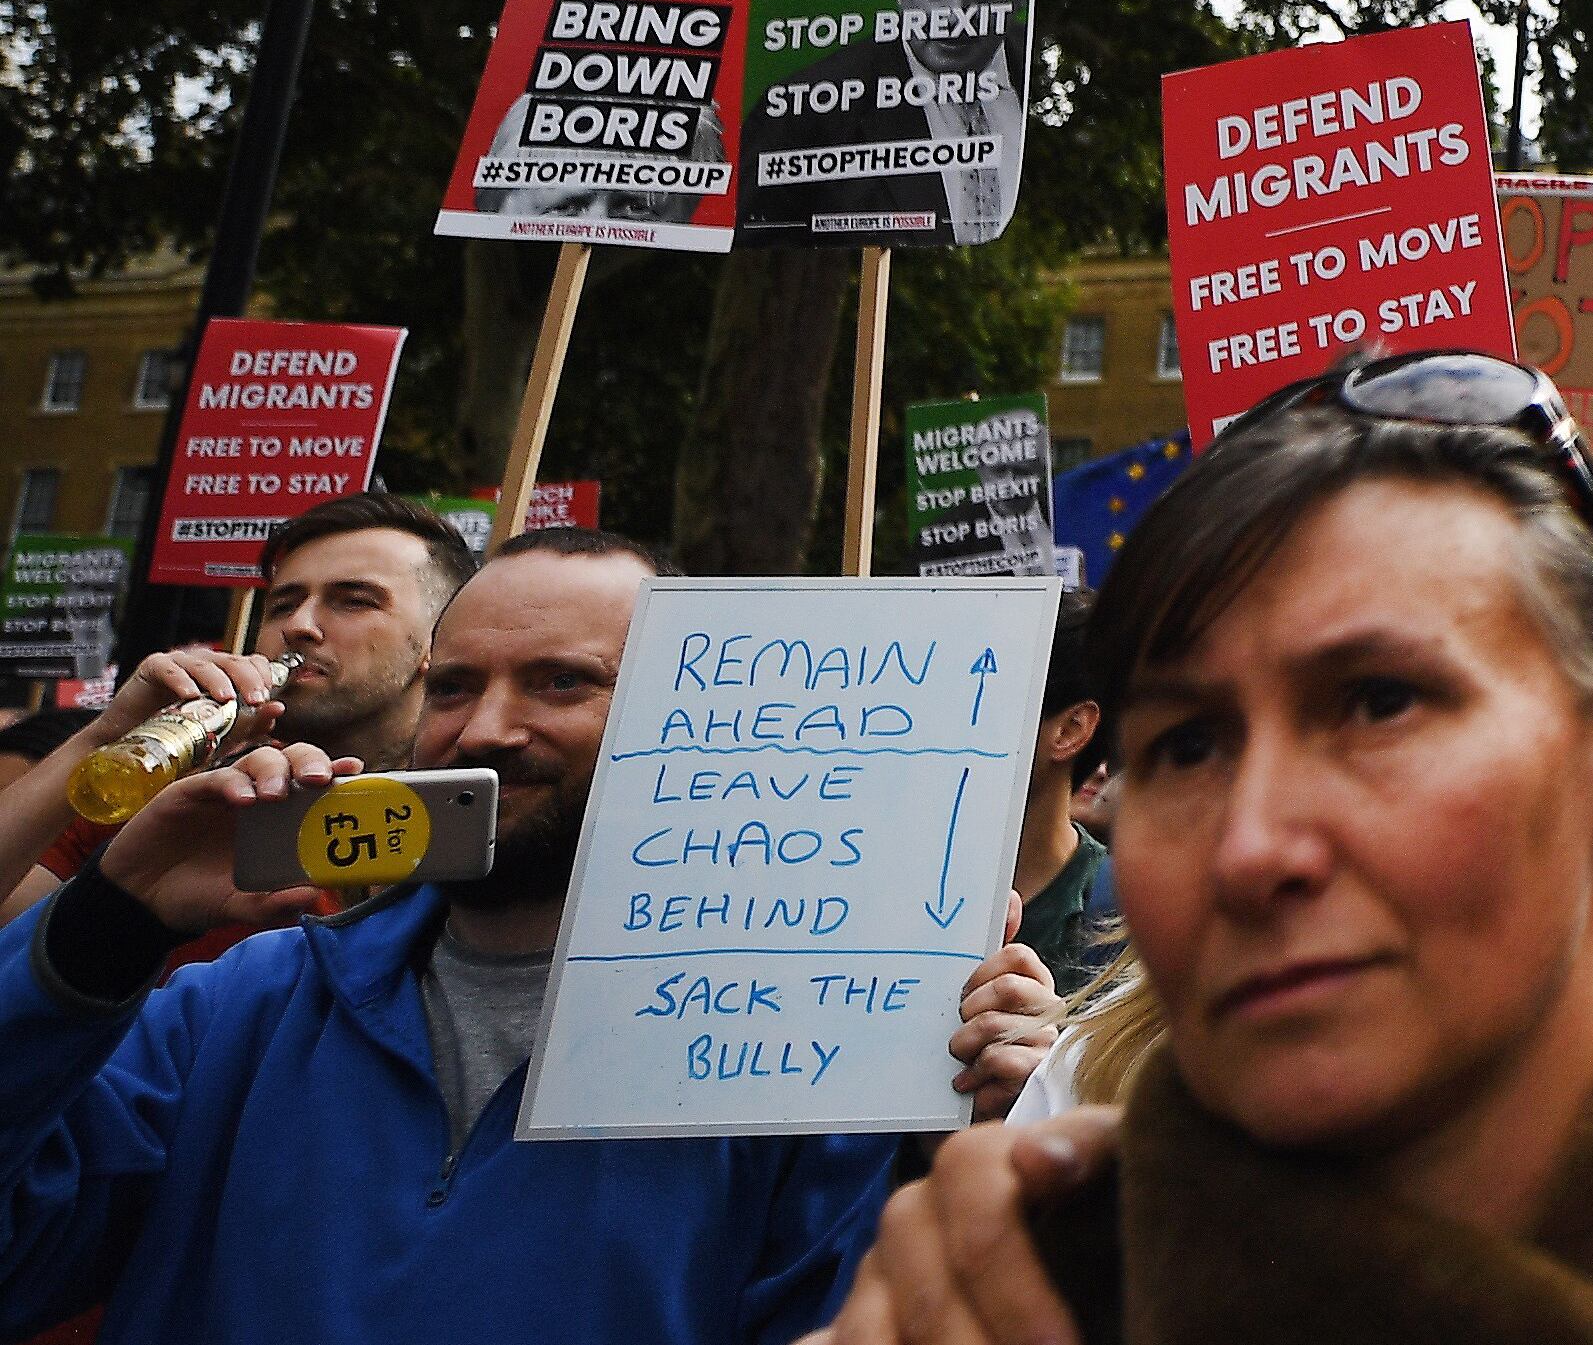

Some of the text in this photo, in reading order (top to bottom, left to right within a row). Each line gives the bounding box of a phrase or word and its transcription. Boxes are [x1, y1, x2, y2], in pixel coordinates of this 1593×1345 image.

[552, 1, 721, 46] BRING
[764, 2, 1013, 53] STOP BREXIT
[535, 52, 712, 99] DOWN
[766, 70, 1001, 119] STOP BORIS
[529, 104, 690, 150] BORIS
[1217, 77, 1422, 159] DEFEND
[482, 162, 726, 190] #STOPTHECOUP
[765, 141, 995, 180] #STOPTHECOUP
[1184, 123, 1470, 227] MIGRANTS
[1189, 214, 1482, 311] FREE TO MOVE
[1208, 281, 1477, 374] FREE TO STAY
[229, 349, 359, 377] DEFEND
[198, 383, 374, 410] MIGRANTS
[186, 436, 365, 458] FREE TO MOVE
[913, 415, 1040, 453] MIGRANTS
[915, 439, 1038, 476] WELCOME
[184, 473, 349, 495] FREE TO STAY
[916, 475, 1041, 512] STOP BREXIT
[920, 522, 970, 547] STOP
[674, 633, 937, 692] REMAIN
[660, 702, 914, 744] AHEAD
[652, 763, 864, 804] LEAVE
[322, 811, 377, 868] £5
[384, 804, 412, 856] 2 for
[631, 820, 864, 868] CHAOS
[623, 892, 849, 936] BEHIND
[635, 971, 921, 1020] SACK THE
[686, 1034, 842, 1086] BULLY
